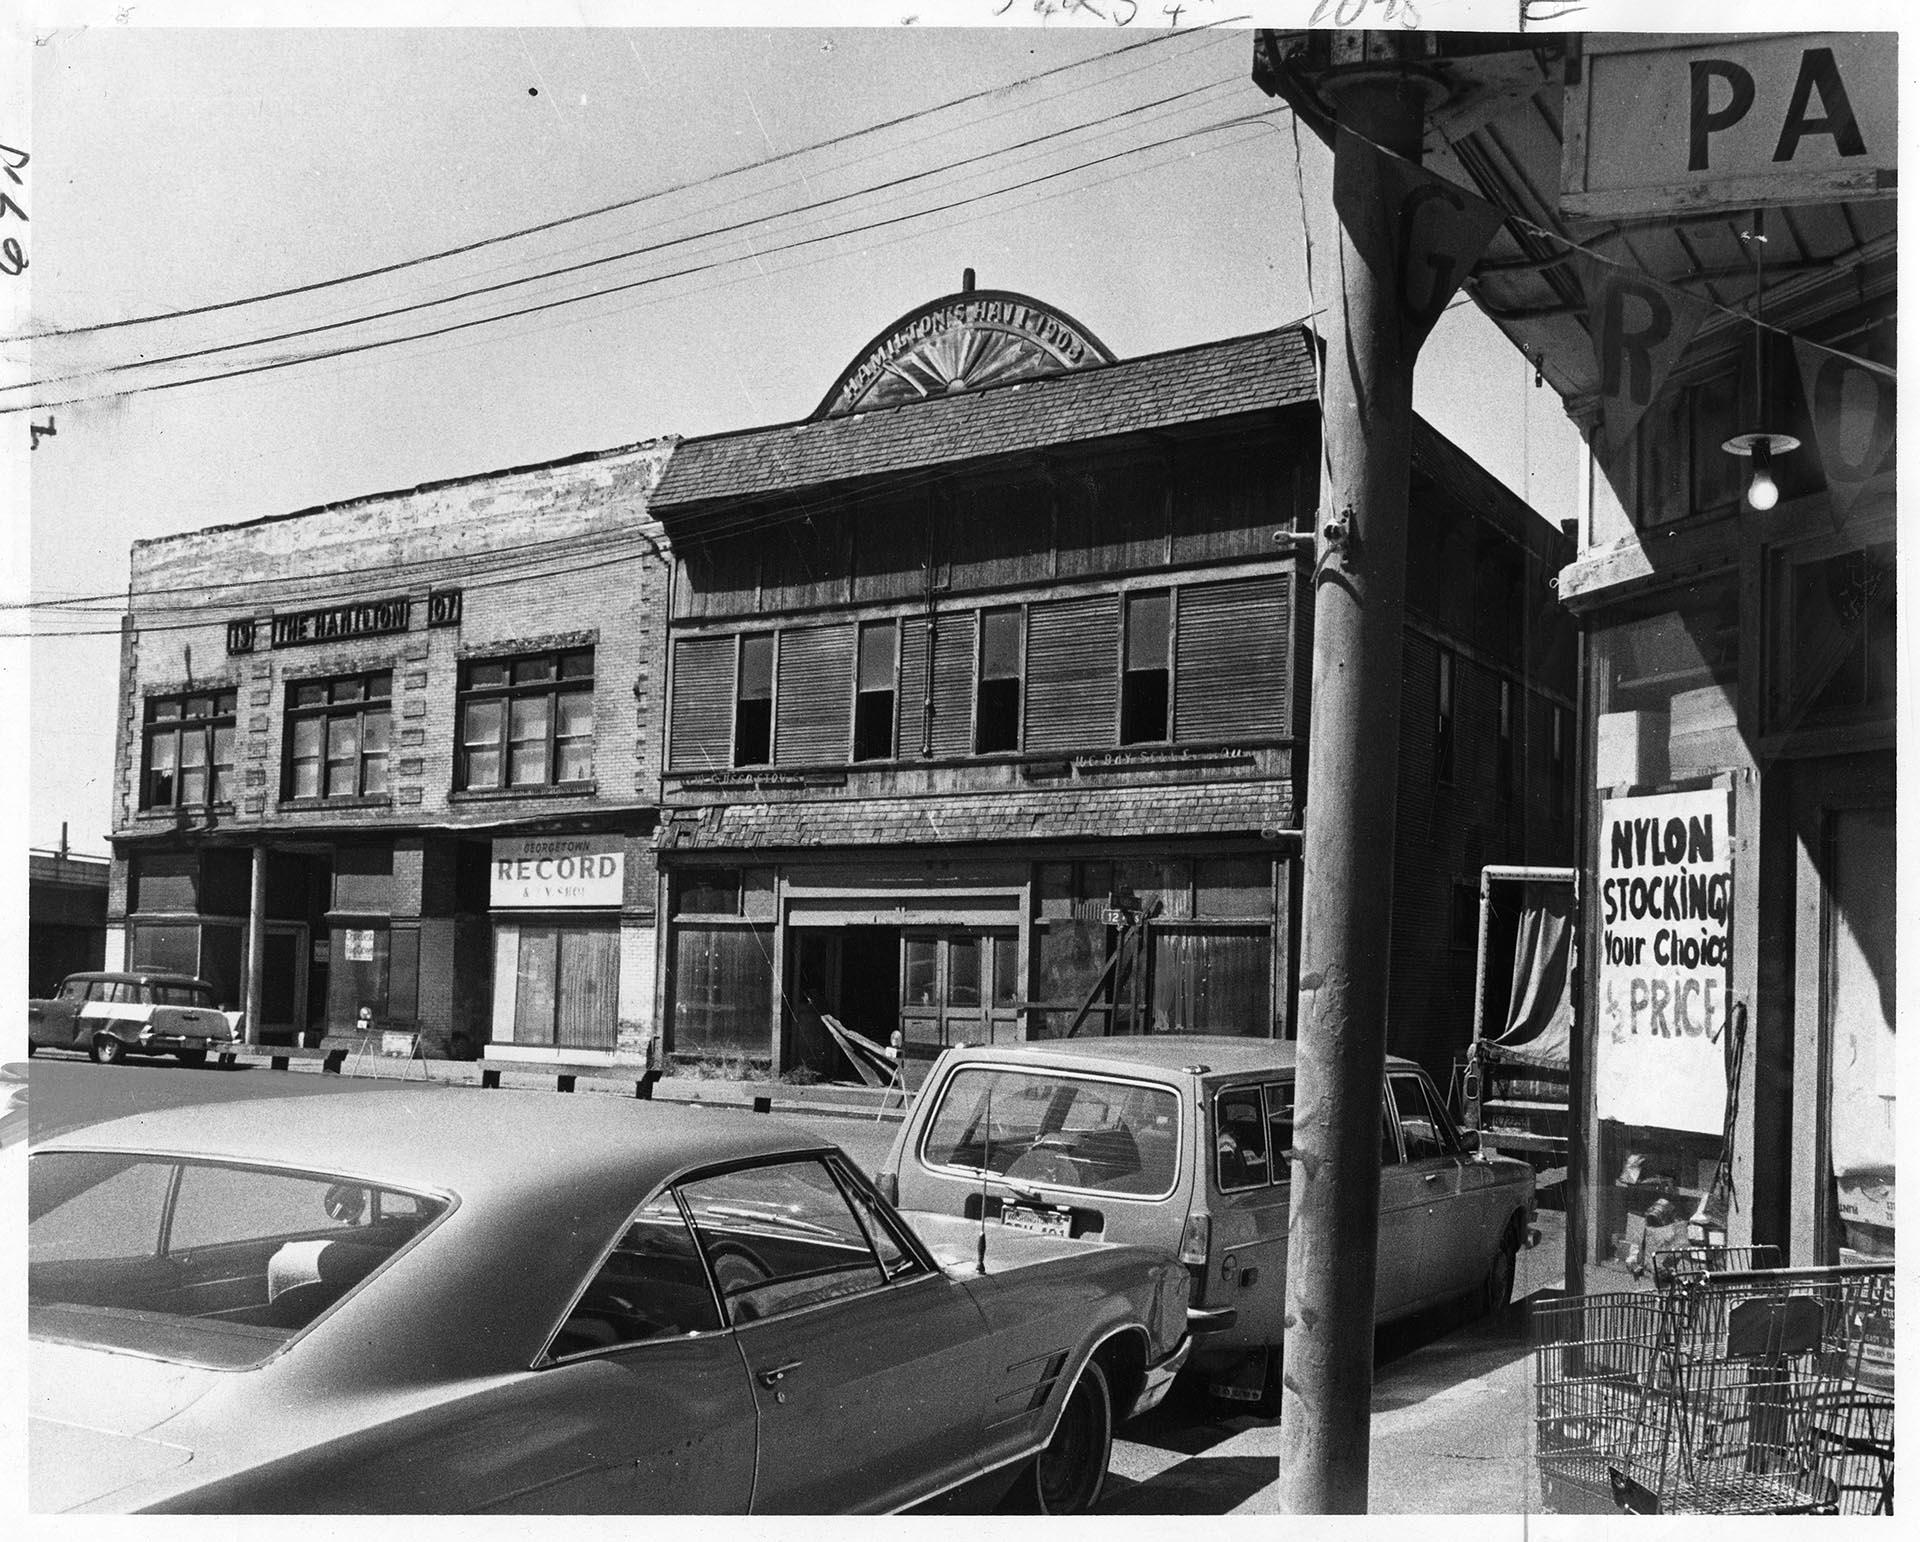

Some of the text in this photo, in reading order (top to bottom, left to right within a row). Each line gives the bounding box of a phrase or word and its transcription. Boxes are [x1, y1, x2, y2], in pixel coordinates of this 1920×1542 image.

[1688, 47, 1867, 171] PA
[524, 842, 590, 854] GEORGETOWN
[1611, 814, 1713, 869] NYLON
[498, 856, 617, 880] RECORD
[1604, 929, 1646, 966] Your
[1630, 977, 1719, 1040] PRICE
